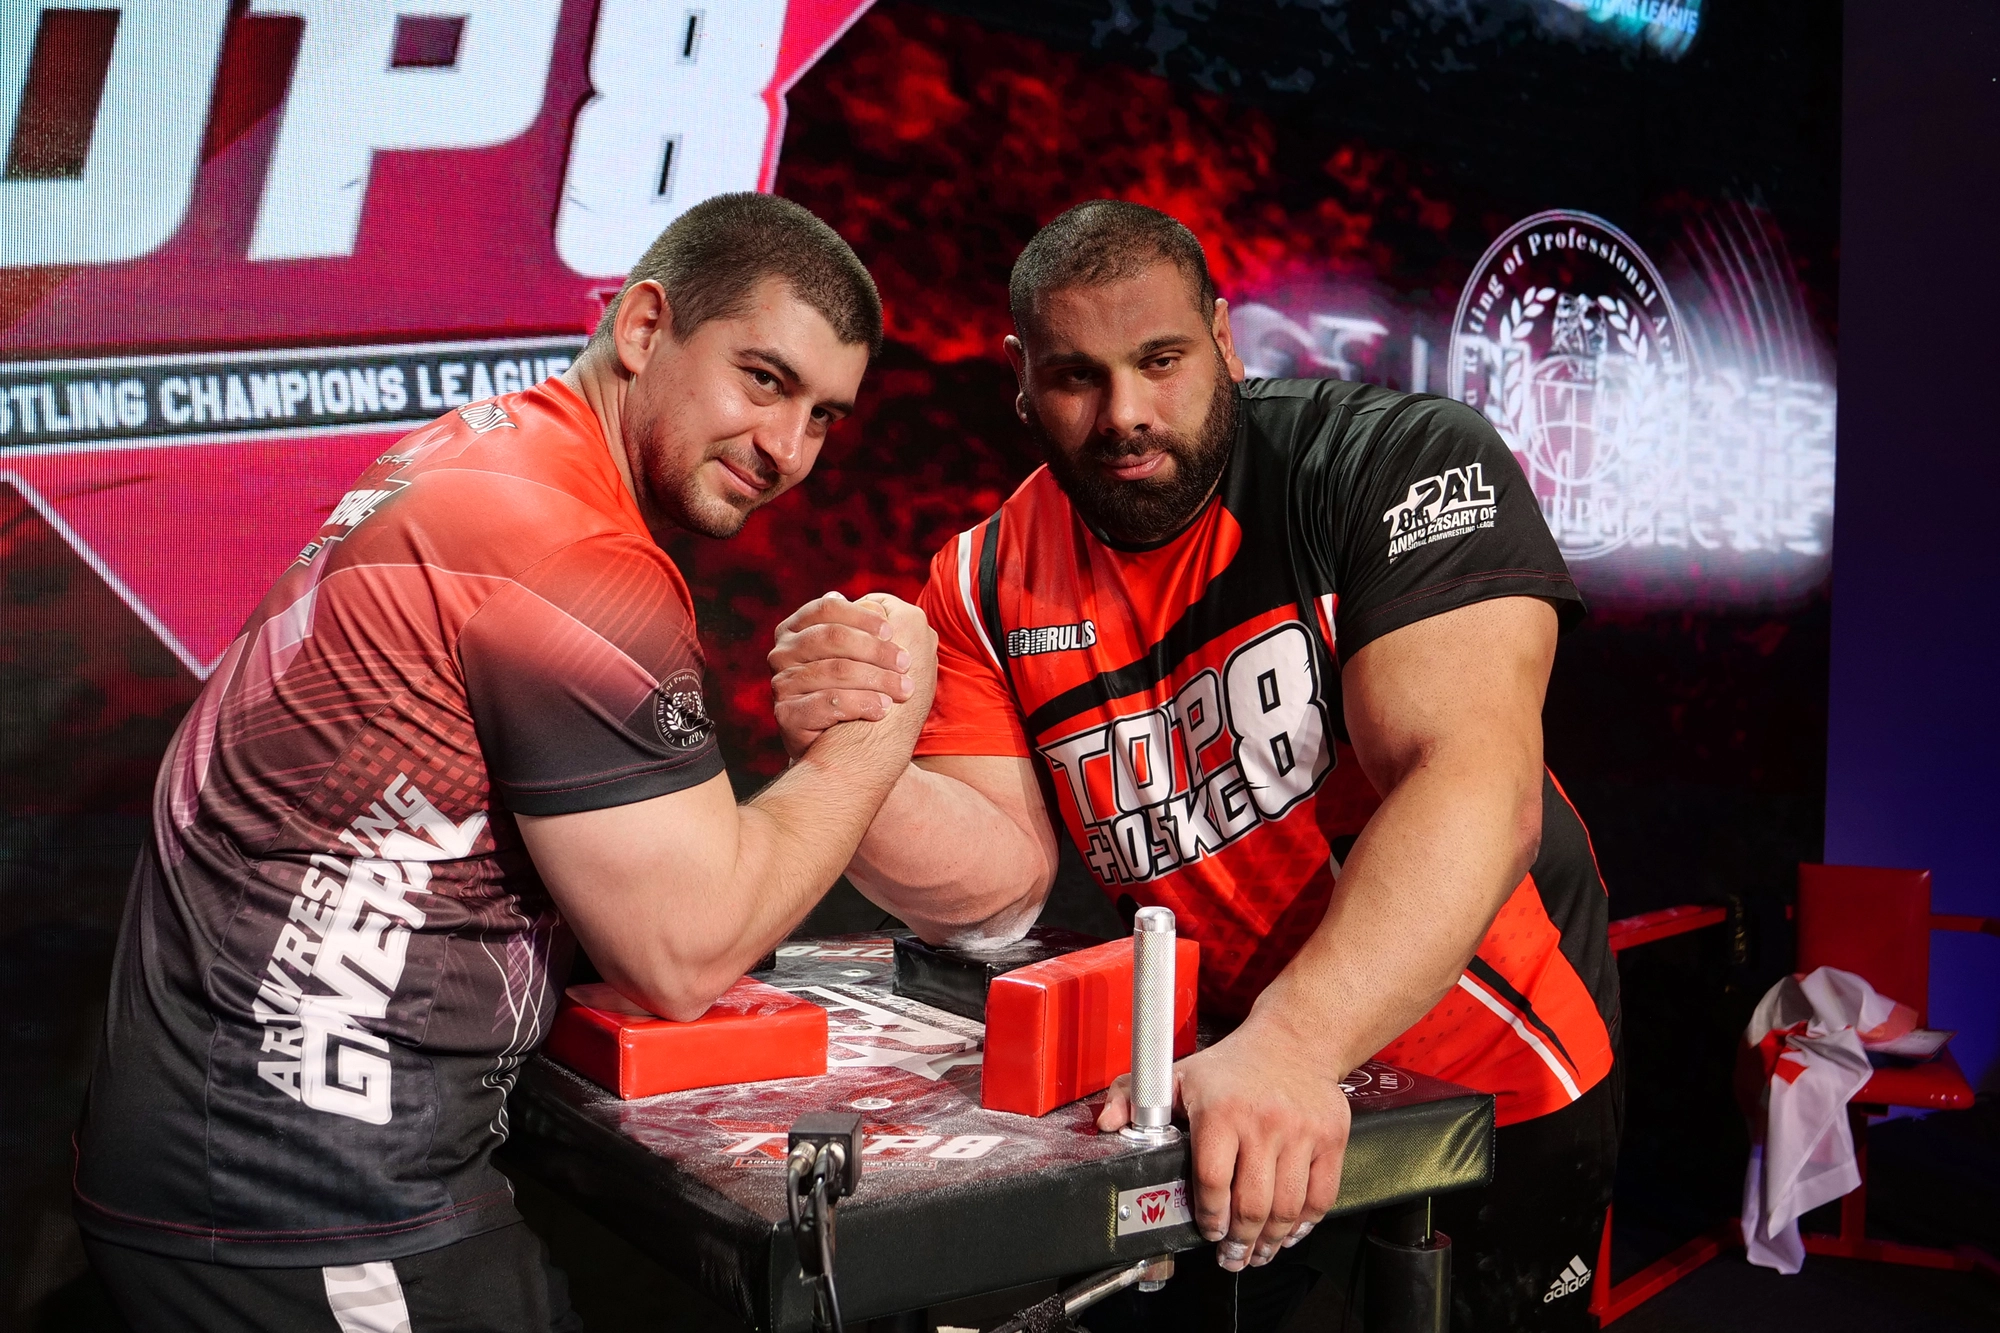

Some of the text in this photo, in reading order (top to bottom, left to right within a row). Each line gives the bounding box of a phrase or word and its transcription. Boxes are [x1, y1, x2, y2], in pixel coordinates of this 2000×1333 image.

[1503, 244, 1525, 275] of
[1528, 227, 1657, 307] Professional
[159, 366, 407, 426] CHAMPIONS
[417, 357, 572, 408] LEAGUE
[1480, 505, 1497, 521] OF
[1428, 527, 1476, 543] ARMWRESTLING
[717, 1132, 1004, 1160] TP8
[1543, 1269, 1592, 1303] adidas
